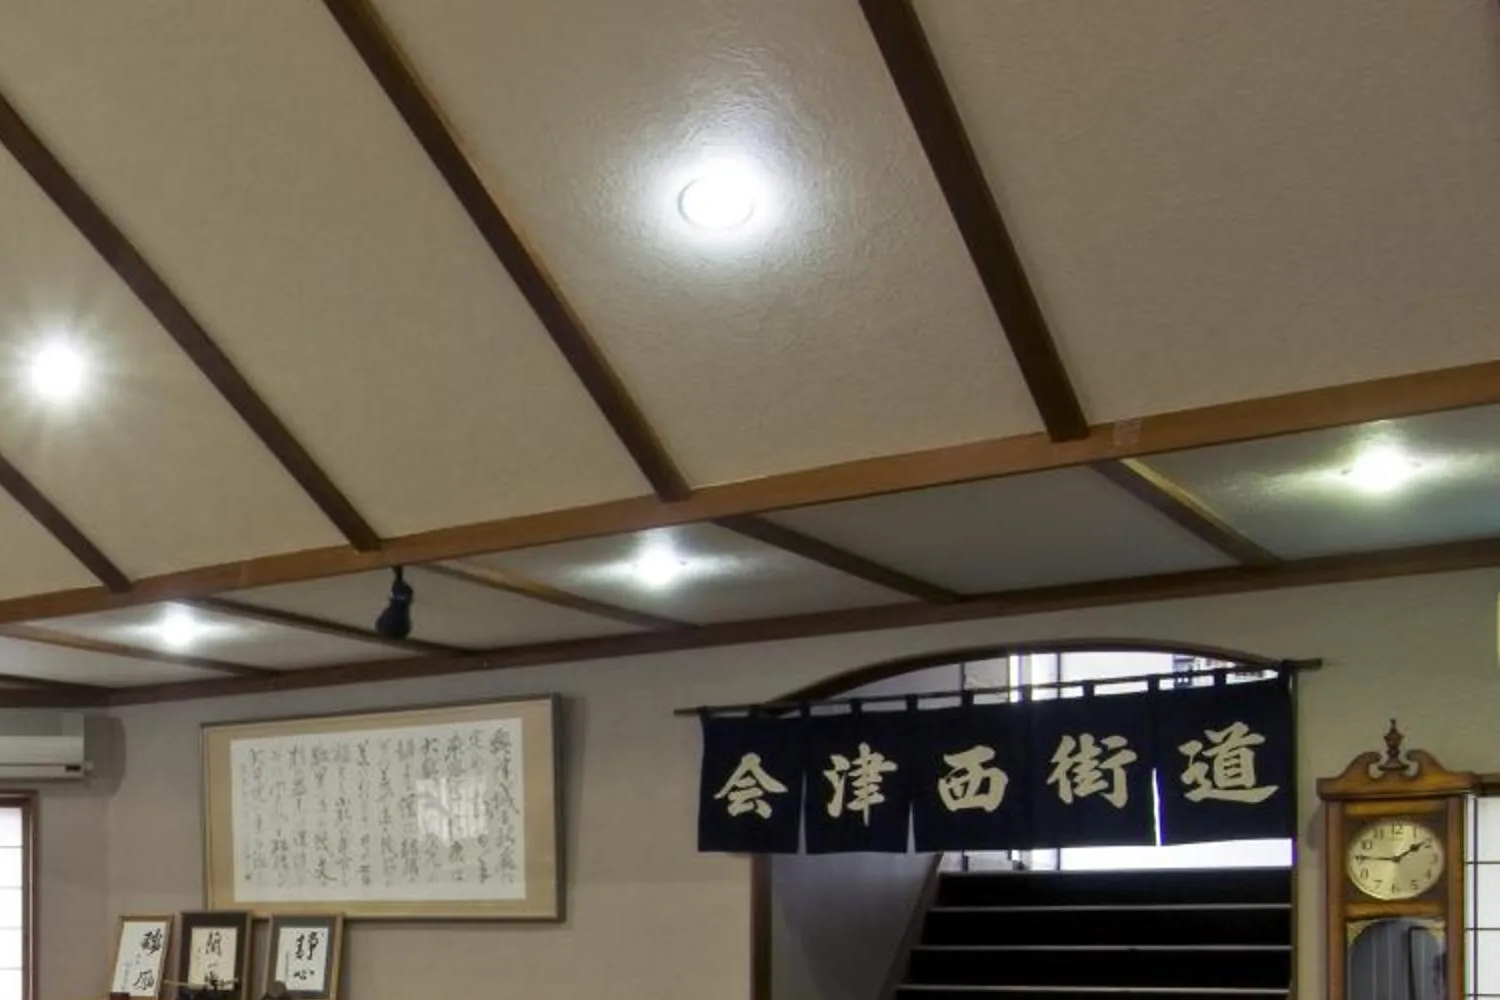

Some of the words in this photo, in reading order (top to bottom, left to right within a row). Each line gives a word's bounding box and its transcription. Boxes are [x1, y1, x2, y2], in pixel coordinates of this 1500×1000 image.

[713, 721, 1279, 827] 会津西街道
